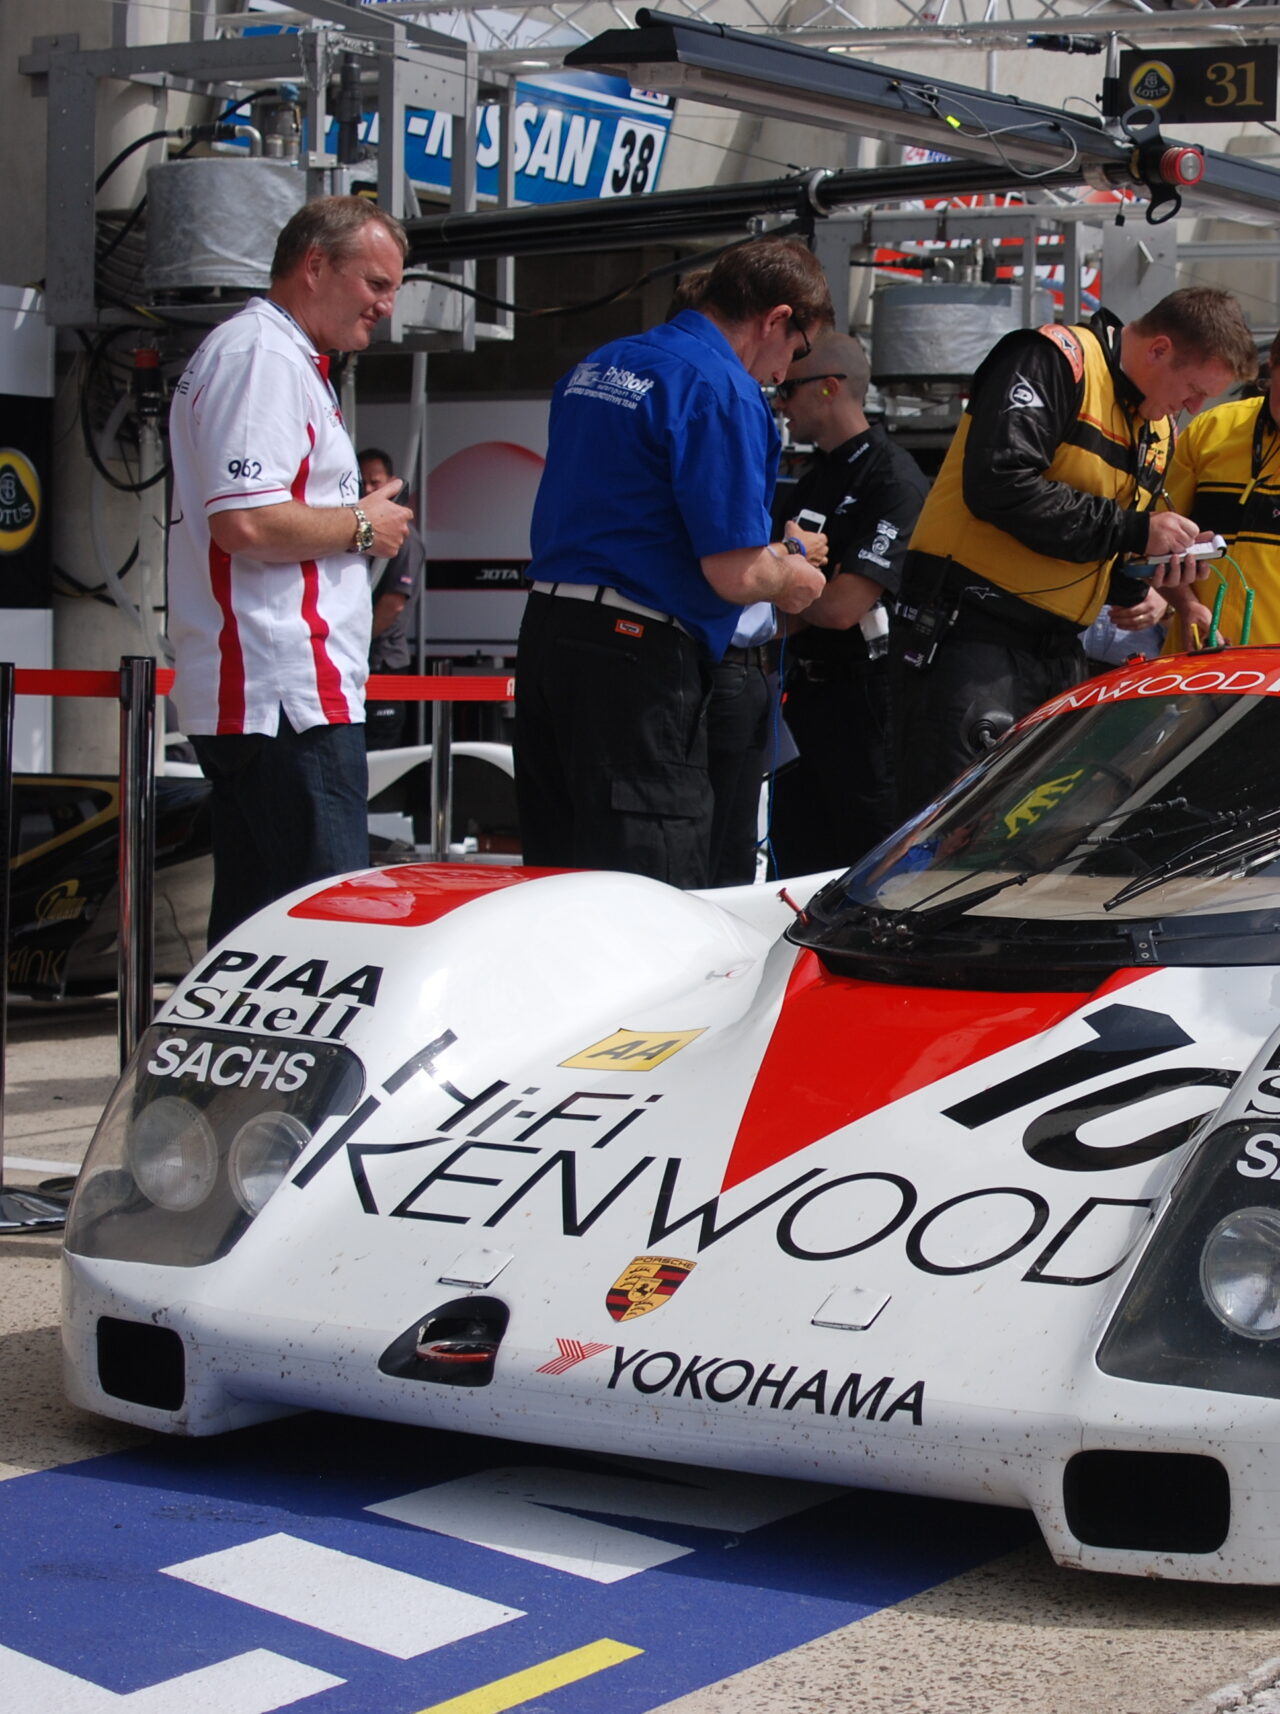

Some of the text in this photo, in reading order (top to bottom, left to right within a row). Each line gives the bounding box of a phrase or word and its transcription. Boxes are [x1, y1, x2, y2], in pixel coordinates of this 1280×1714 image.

[1136, 61, 1264, 107] LOTUS 31
[612, 128, 656, 194] 38
[228, 458, 263, 481] 962
[475, 569, 519, 581] JOTA
[194, 950, 384, 1007] PIAA
[168, 986, 362, 1041] Shell
[147, 1038, 316, 1092] SACHS
[587, 1039, 681, 1062] AA
[382, 1028, 665, 1149] Hi-Fi
[940, 1003, 1240, 1172] 10
[291, 1094, 1157, 1287] KENWOOD
[633, 1256, 694, 1269] PORSCHE
[607, 1346, 926, 1426] YOKOHAMA
